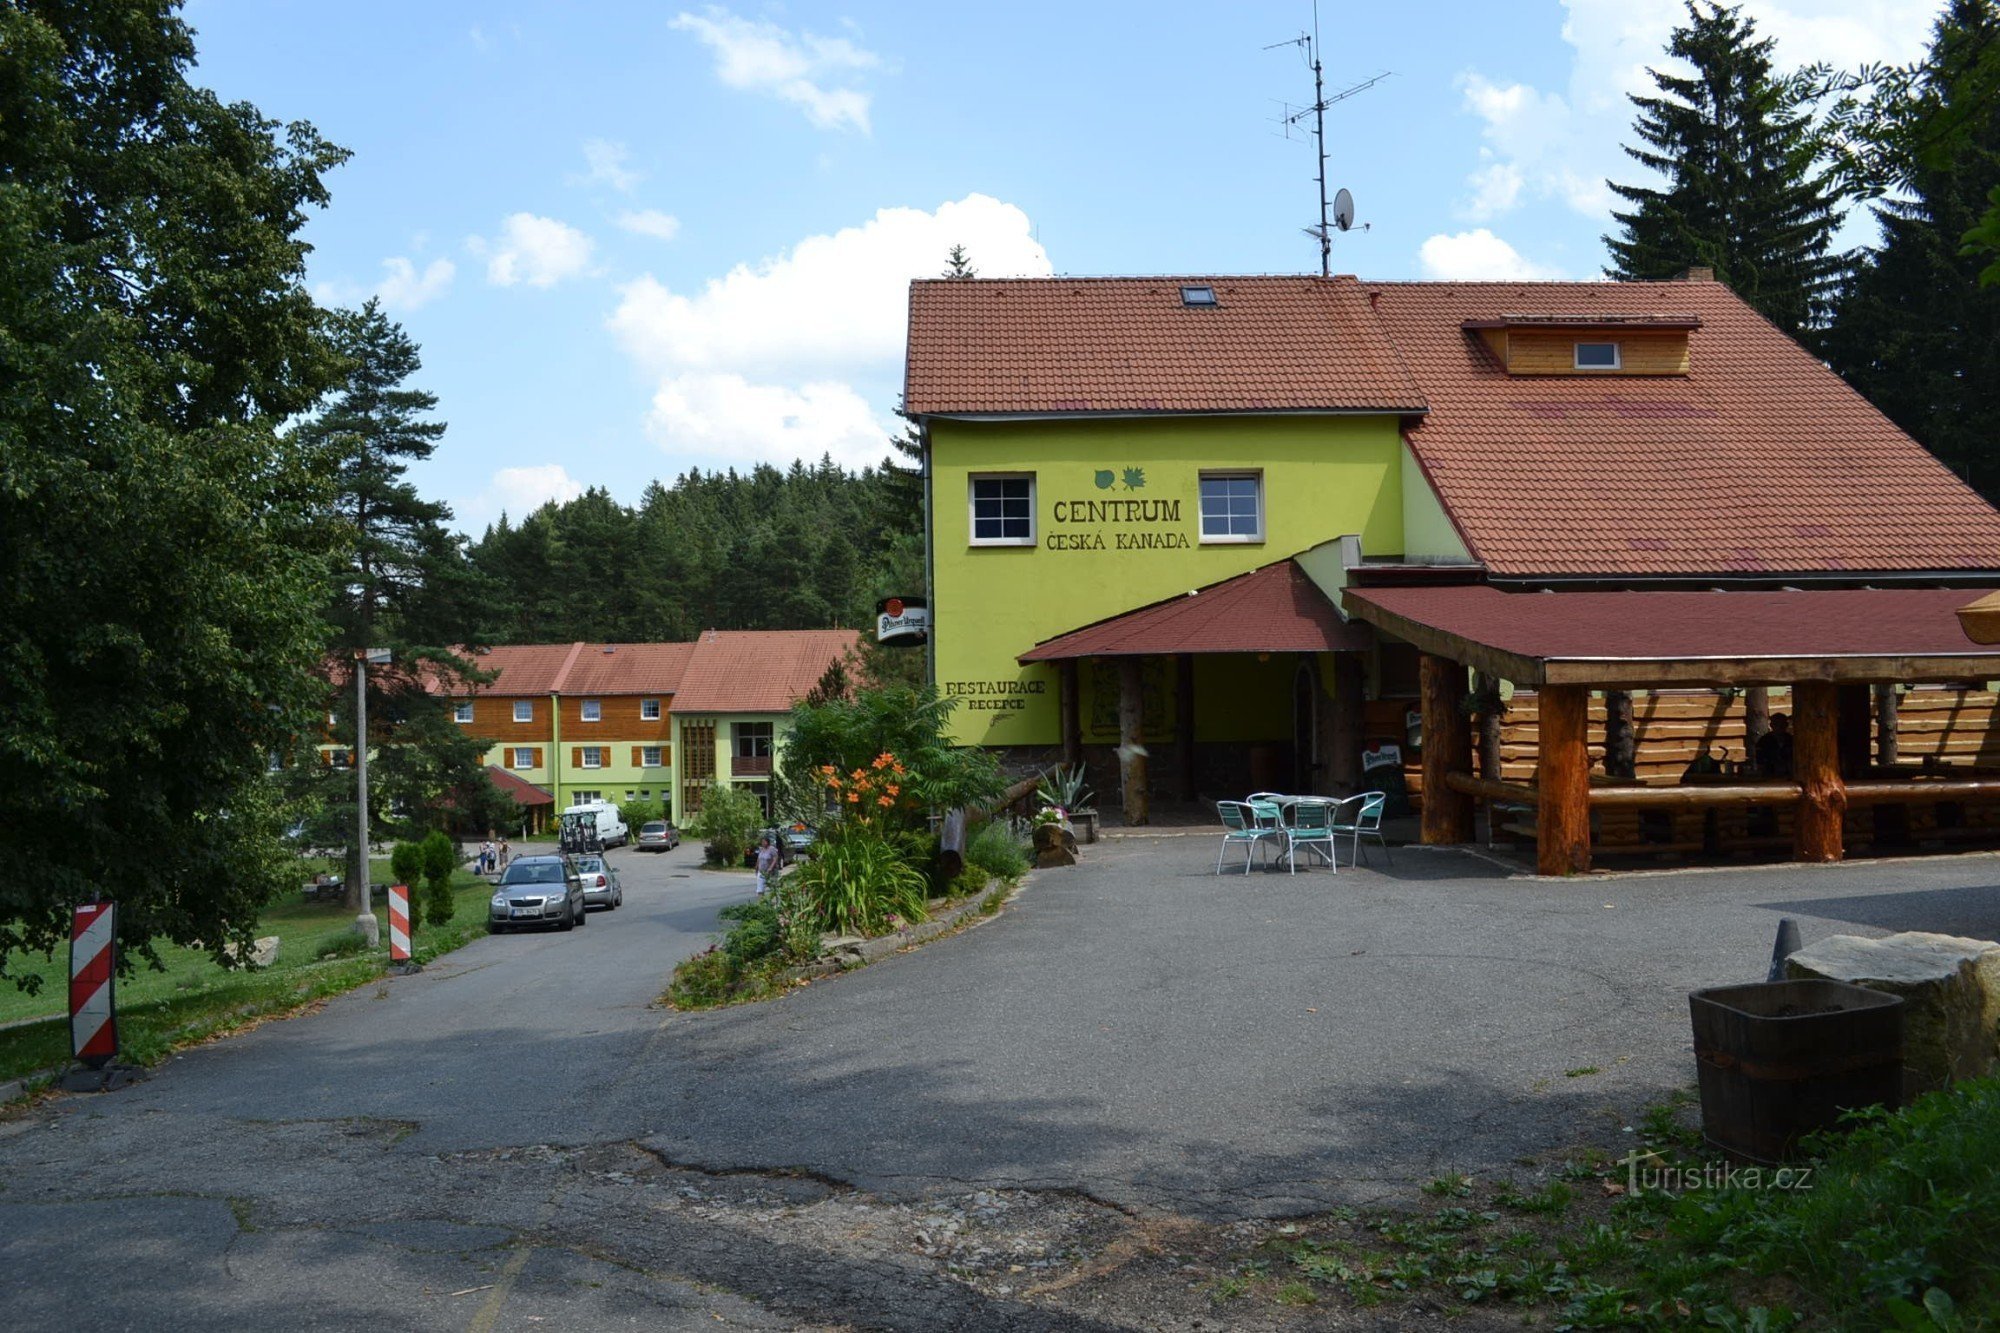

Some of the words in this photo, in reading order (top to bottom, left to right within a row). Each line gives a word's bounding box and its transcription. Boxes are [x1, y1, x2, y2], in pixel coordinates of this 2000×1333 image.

[1053, 499, 1181, 523] CENTRUM
[1046, 529, 1106, 551] ČESKÁ
[1115, 532, 1190, 550] KANADA
[945, 680, 1046, 695] RESTAURACE
[968, 699, 1025, 710] RECEPCE
